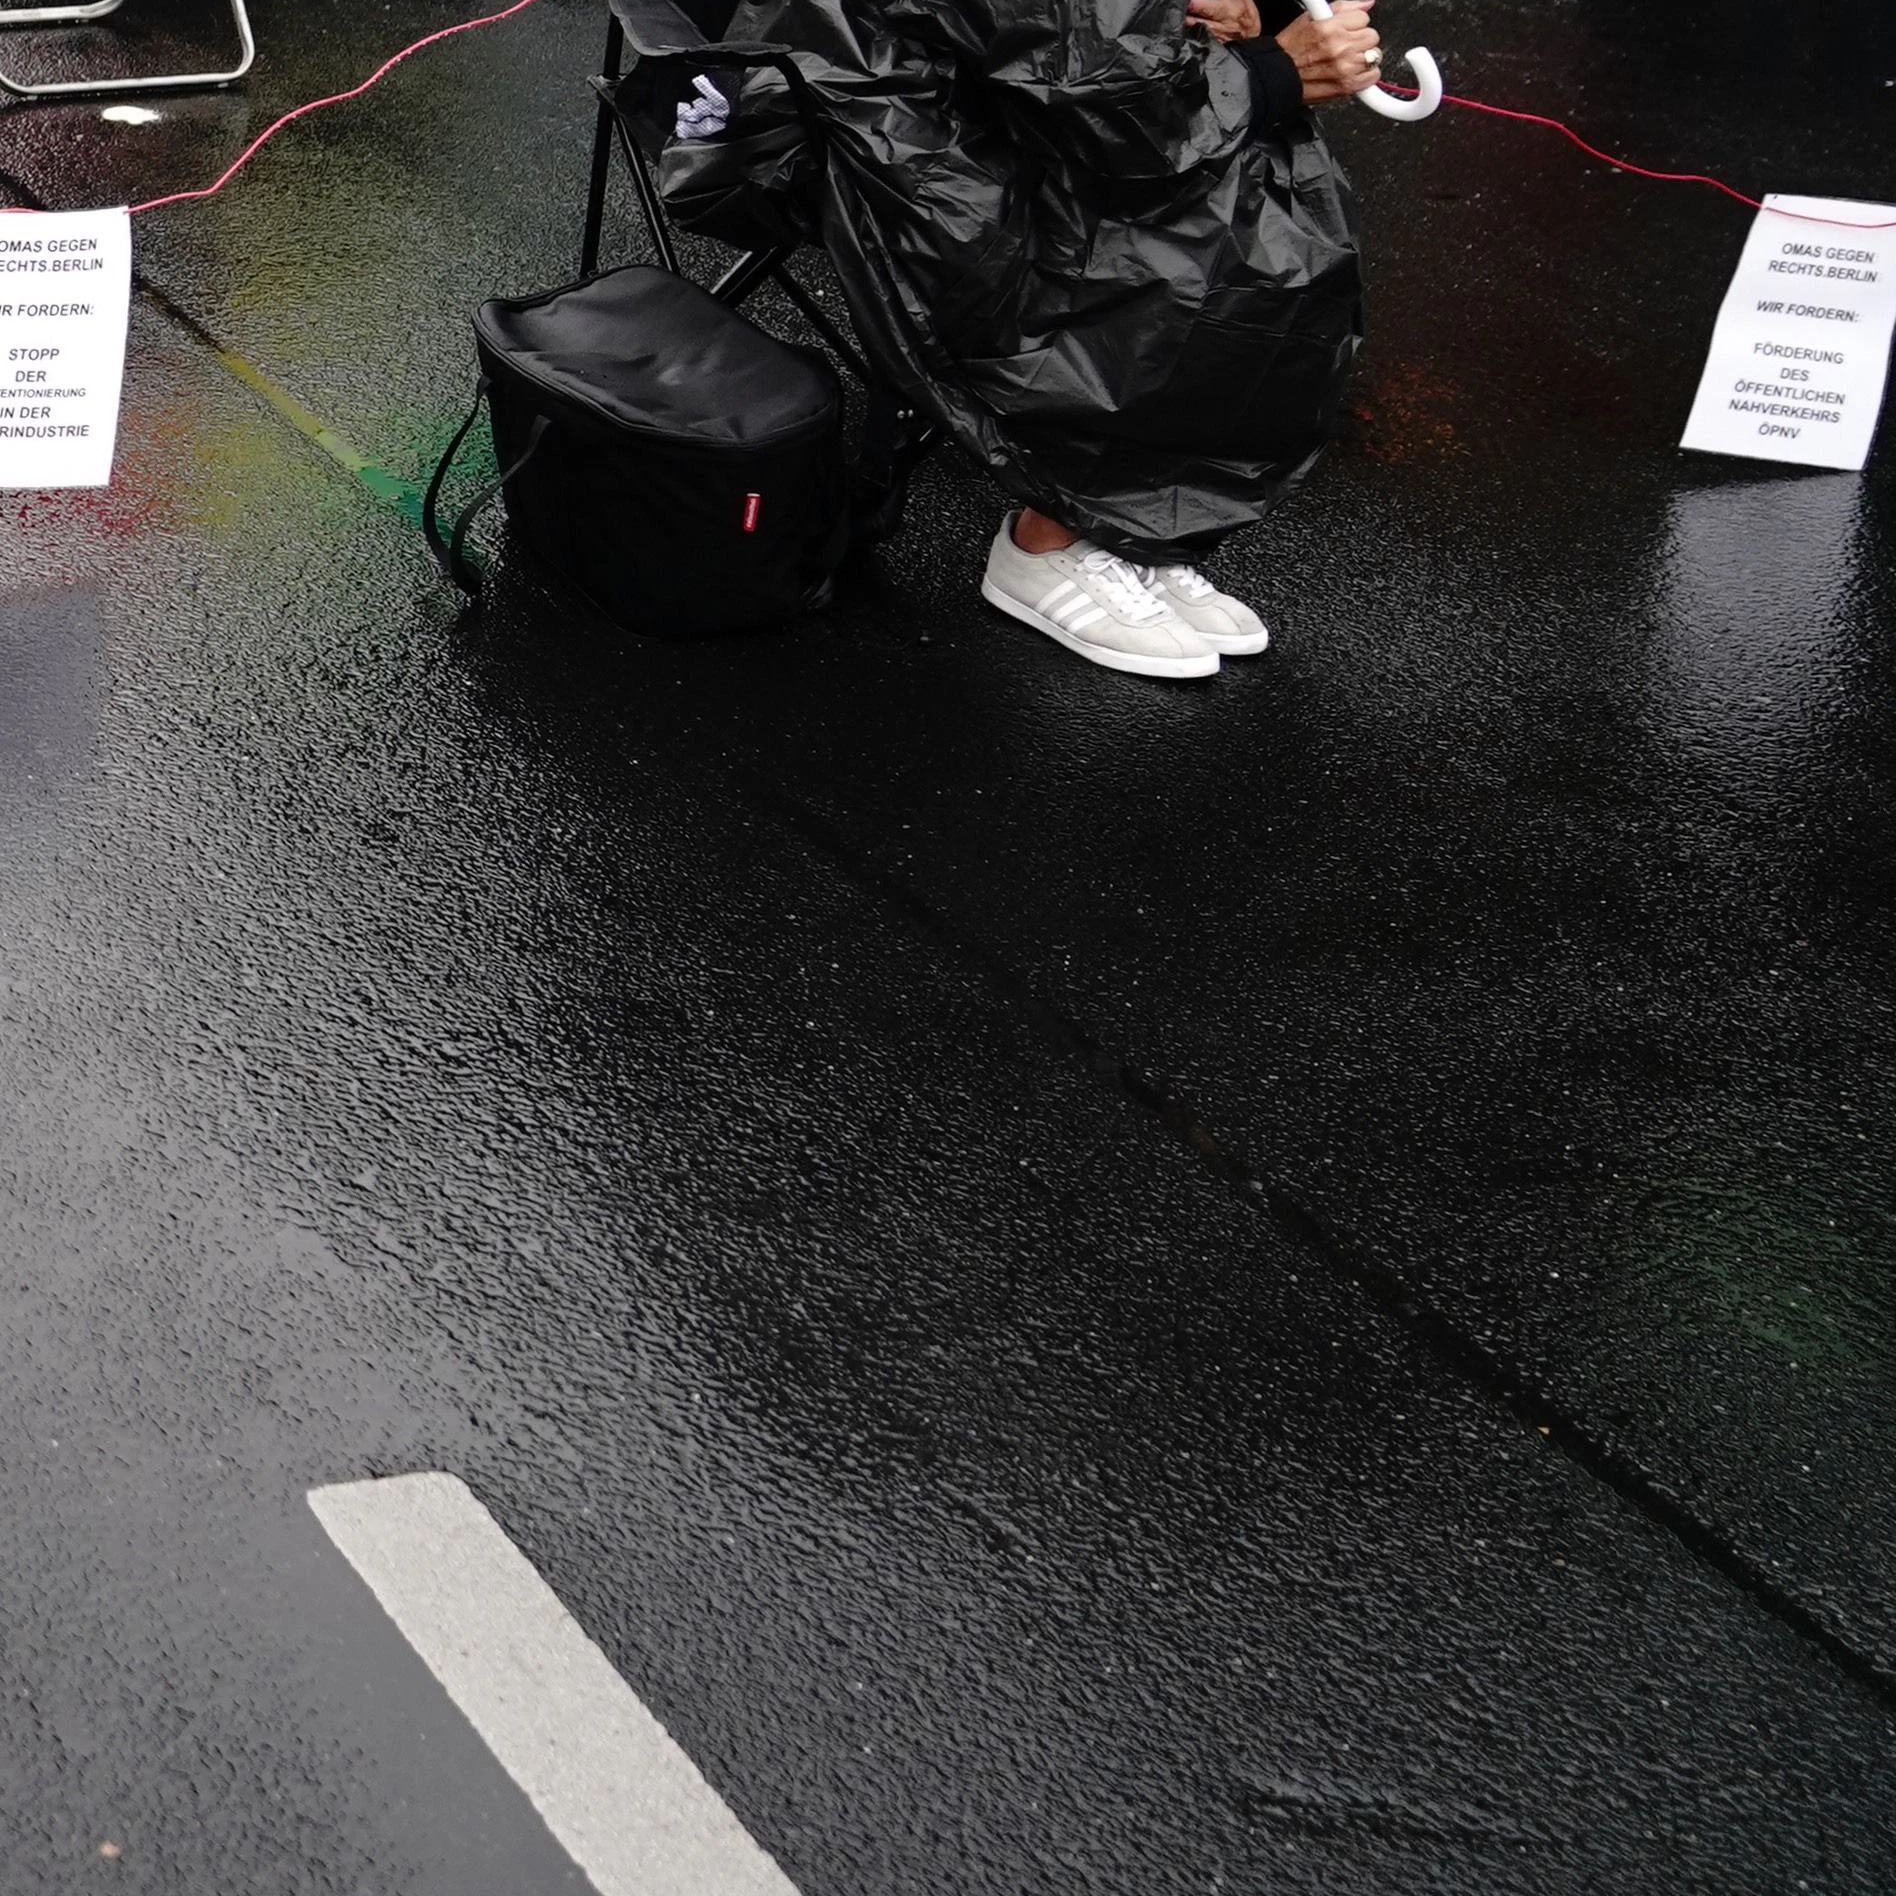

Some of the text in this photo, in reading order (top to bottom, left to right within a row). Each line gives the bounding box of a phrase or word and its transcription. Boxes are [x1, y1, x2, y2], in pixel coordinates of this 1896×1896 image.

[48, 238, 98, 252] GEGEN
[1782, 242, 1874, 264] OMAS GEGEN
[17, 304, 94, 316] FORDERN:
[1756, 300, 1860, 322] WIR FORDERN:
[8, 348, 60, 361] STOPP
[1754, 341, 1844, 364] FÖRDERUNG
[16, 370, 46, 382] DER
[1780, 368, 1809, 382] DES
[1734, 379, 1846, 405] ÖFFENTLICHEN
[0, 406, 51, 419] IN DER
[1728, 399, 1841, 424] NAHVERKEHRS
[1758, 424, 1800, 440] ÖPNV
